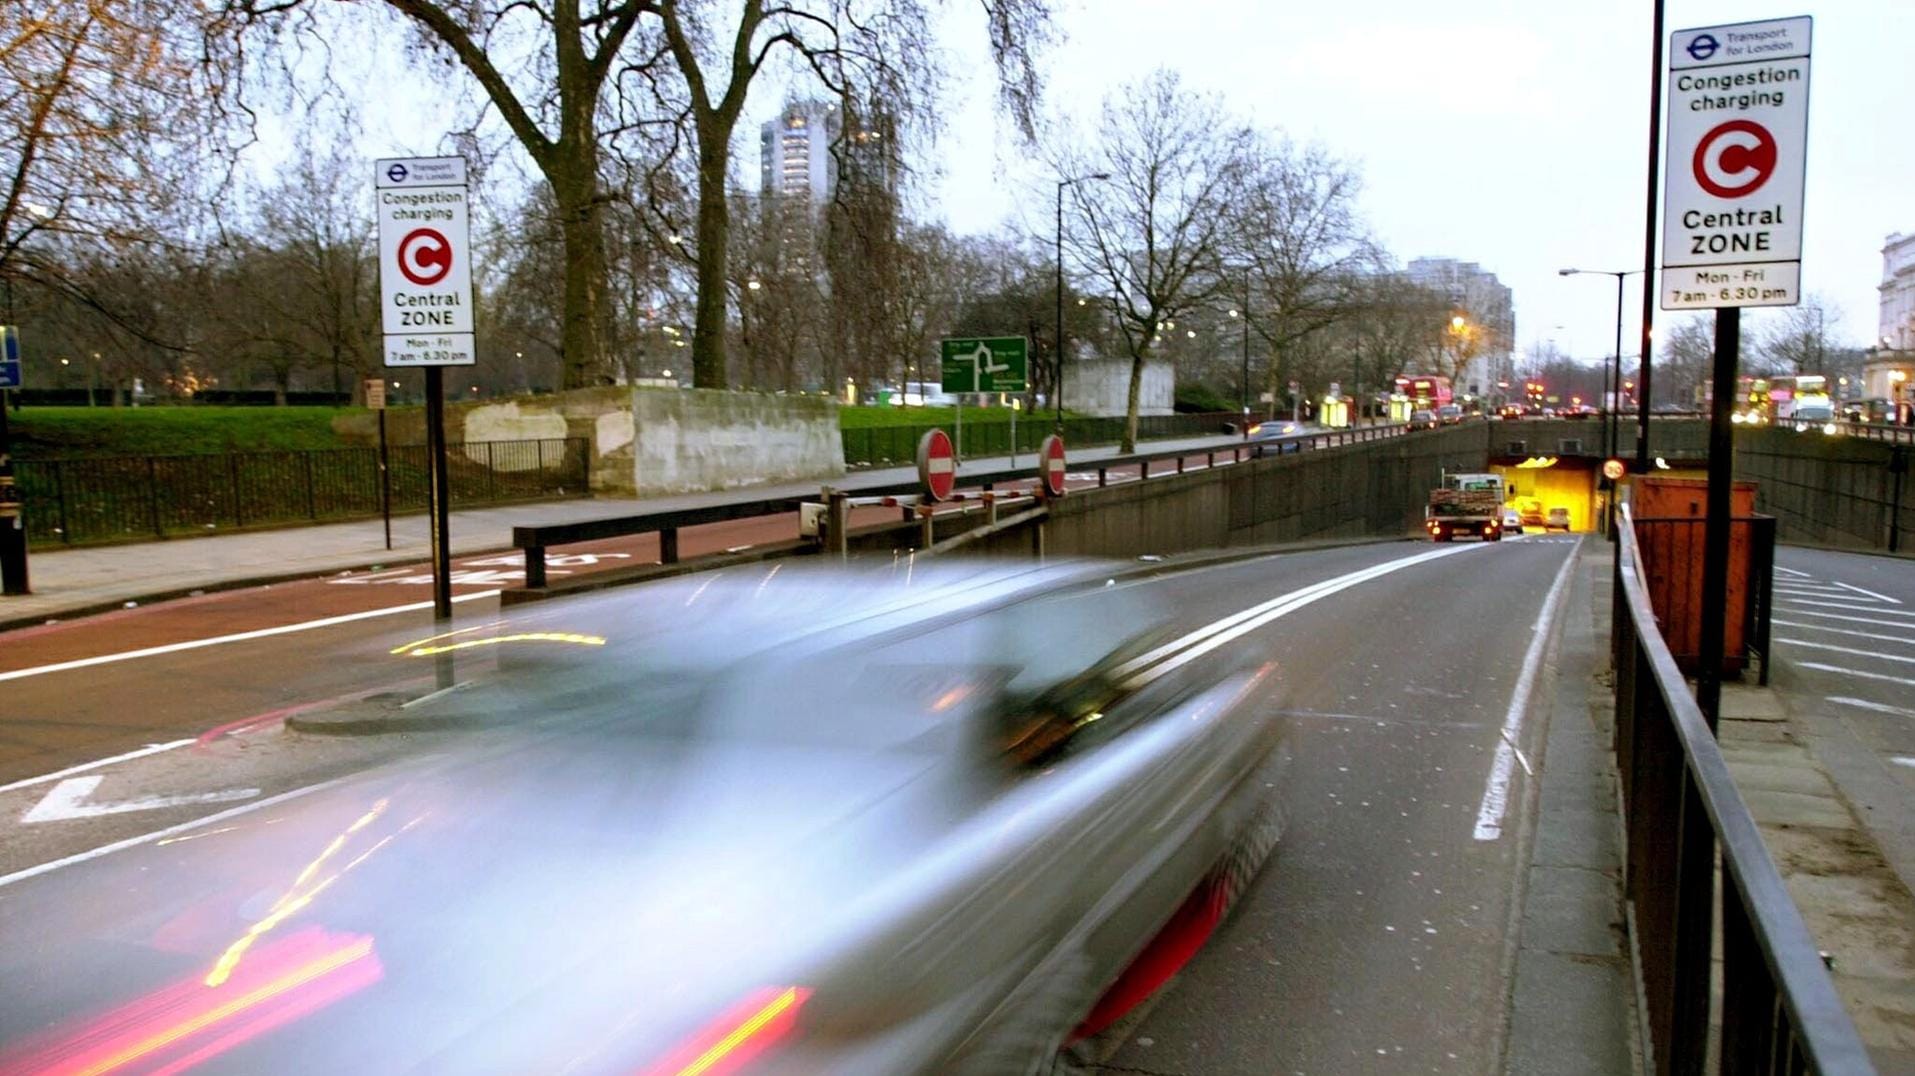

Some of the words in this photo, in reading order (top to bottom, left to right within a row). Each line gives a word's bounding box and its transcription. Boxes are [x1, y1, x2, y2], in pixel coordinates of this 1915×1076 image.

[1726, 28, 1787, 43] Transport
[1726, 47, 1743, 56] for
[1746, 41, 1794, 54] London
[1678, 68, 1800, 91] Congestion
[1690, 91, 1784, 111] charging
[383, 192, 462, 206] Congestion
[392, 207, 454, 221] charging
[1683, 205, 1783, 229] Central
[1691, 232, 1770, 254] ZONE
[1695, 272, 1729, 283] Mon
[1743, 270, 1765, 281] Fri
[394, 291, 461, 307] Central
[1719, 287, 1758, 300] 6.30
[401, 310, 454, 326] ZONE
